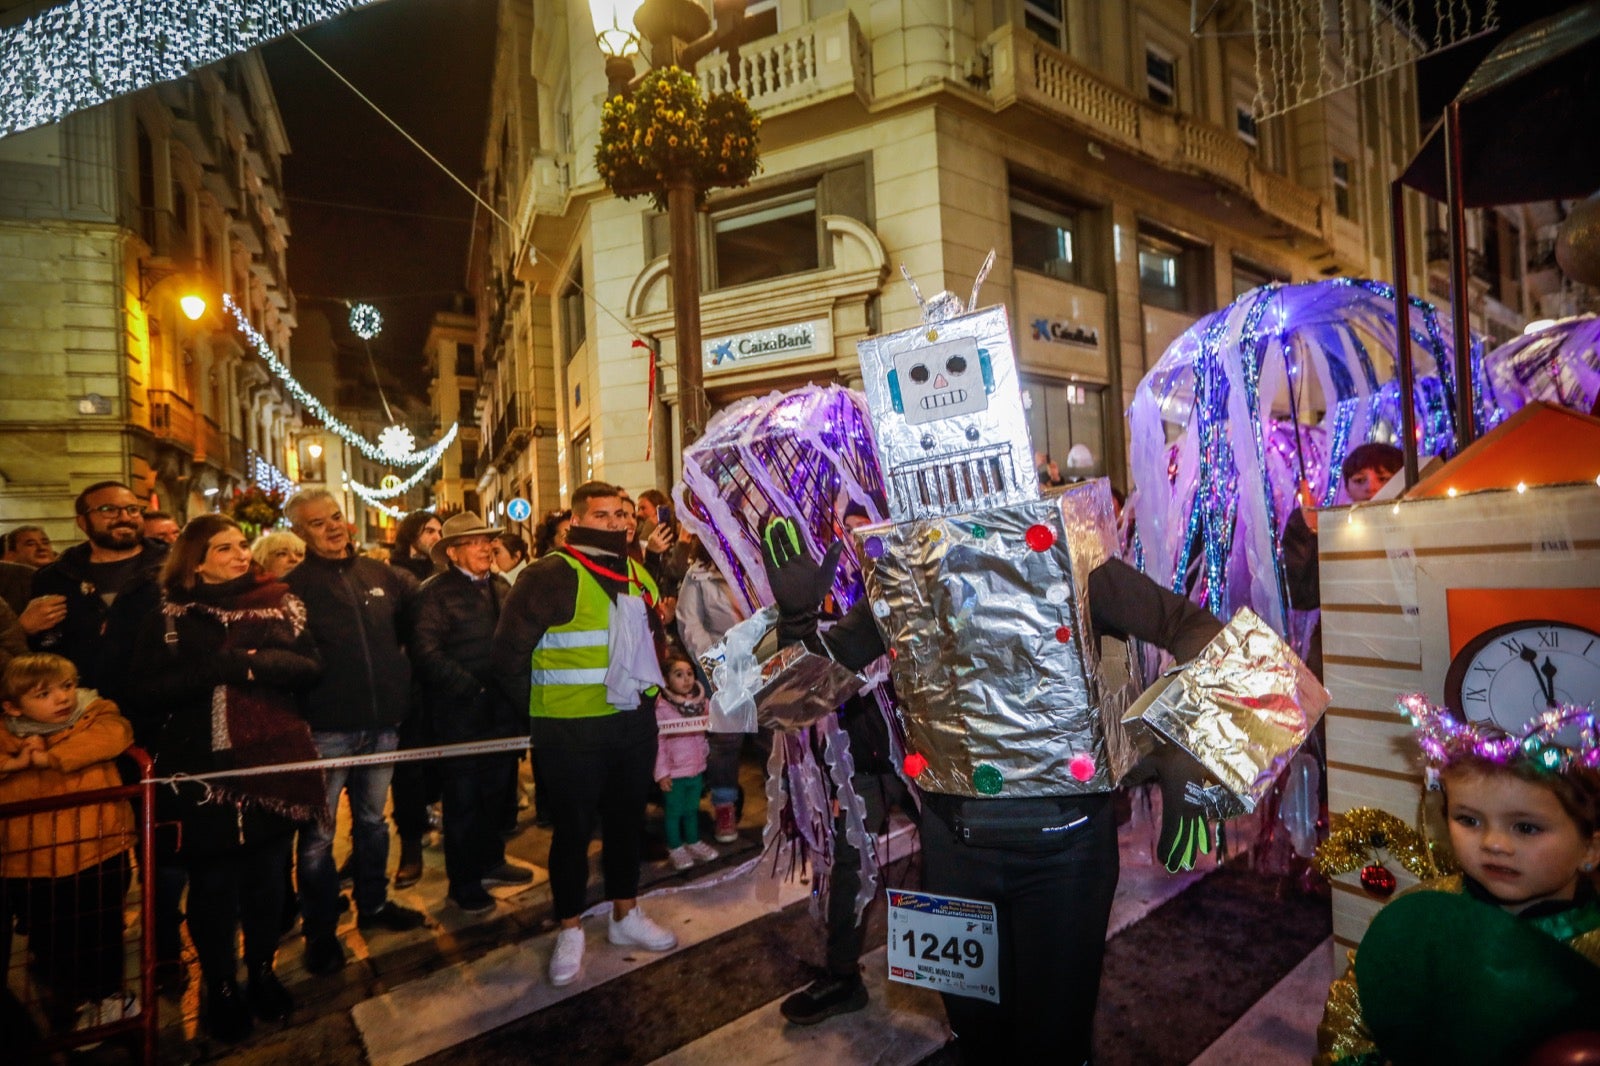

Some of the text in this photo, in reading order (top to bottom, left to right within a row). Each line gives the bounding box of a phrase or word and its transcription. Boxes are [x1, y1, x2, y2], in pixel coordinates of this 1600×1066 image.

[738, 330, 812, 354] CaixaBank
[1537, 631, 1559, 647] XII
[1474, 661, 1496, 678] X
[902, 929, 984, 969] 1249
[918, 964, 935, 974] MANUEL
